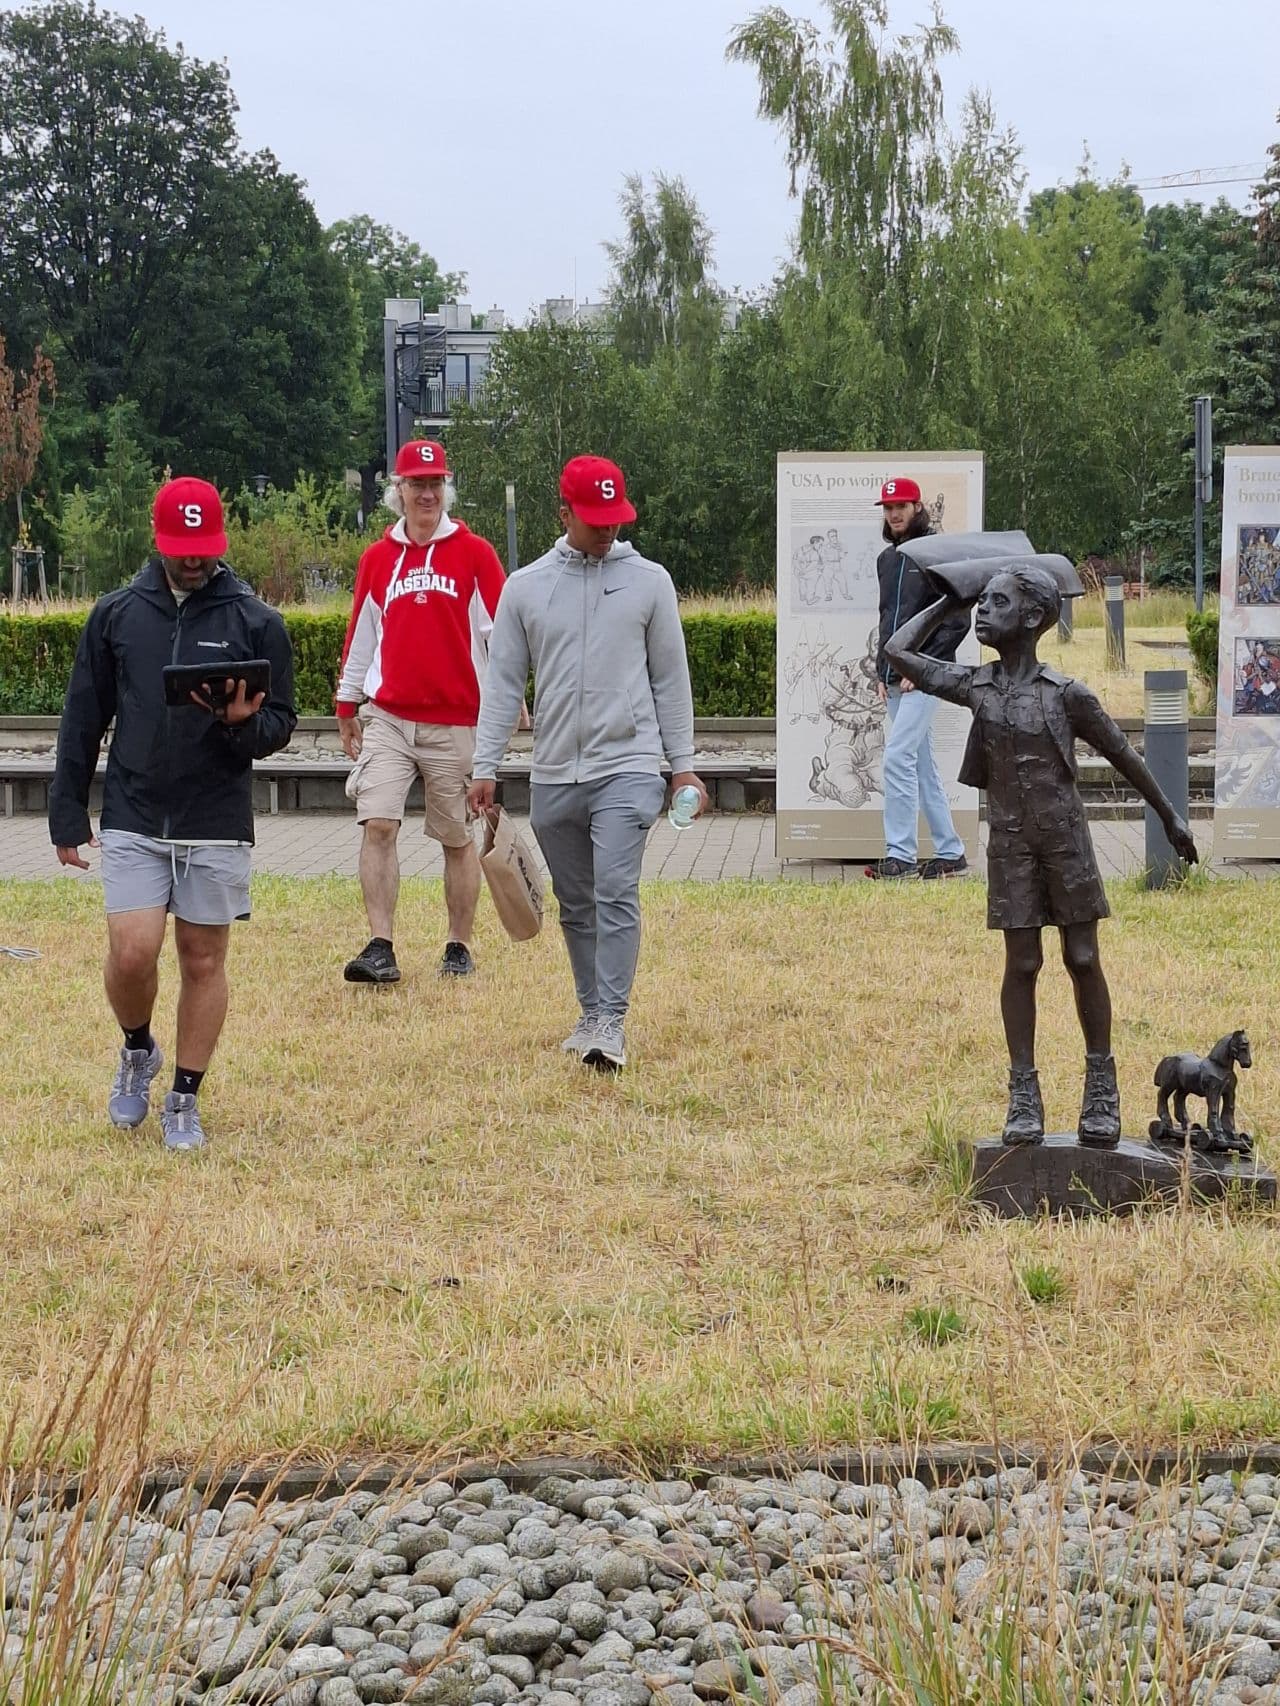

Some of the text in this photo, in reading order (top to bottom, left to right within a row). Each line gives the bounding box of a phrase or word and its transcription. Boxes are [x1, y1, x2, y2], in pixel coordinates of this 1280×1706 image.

[421, 446, 435, 462] S
[600, 479, 615, 499] S
[791, 473, 823, 488] USA
[826, 477, 846, 491] po
[886, 482, 896, 494] S
[184, 504, 202, 527] S
